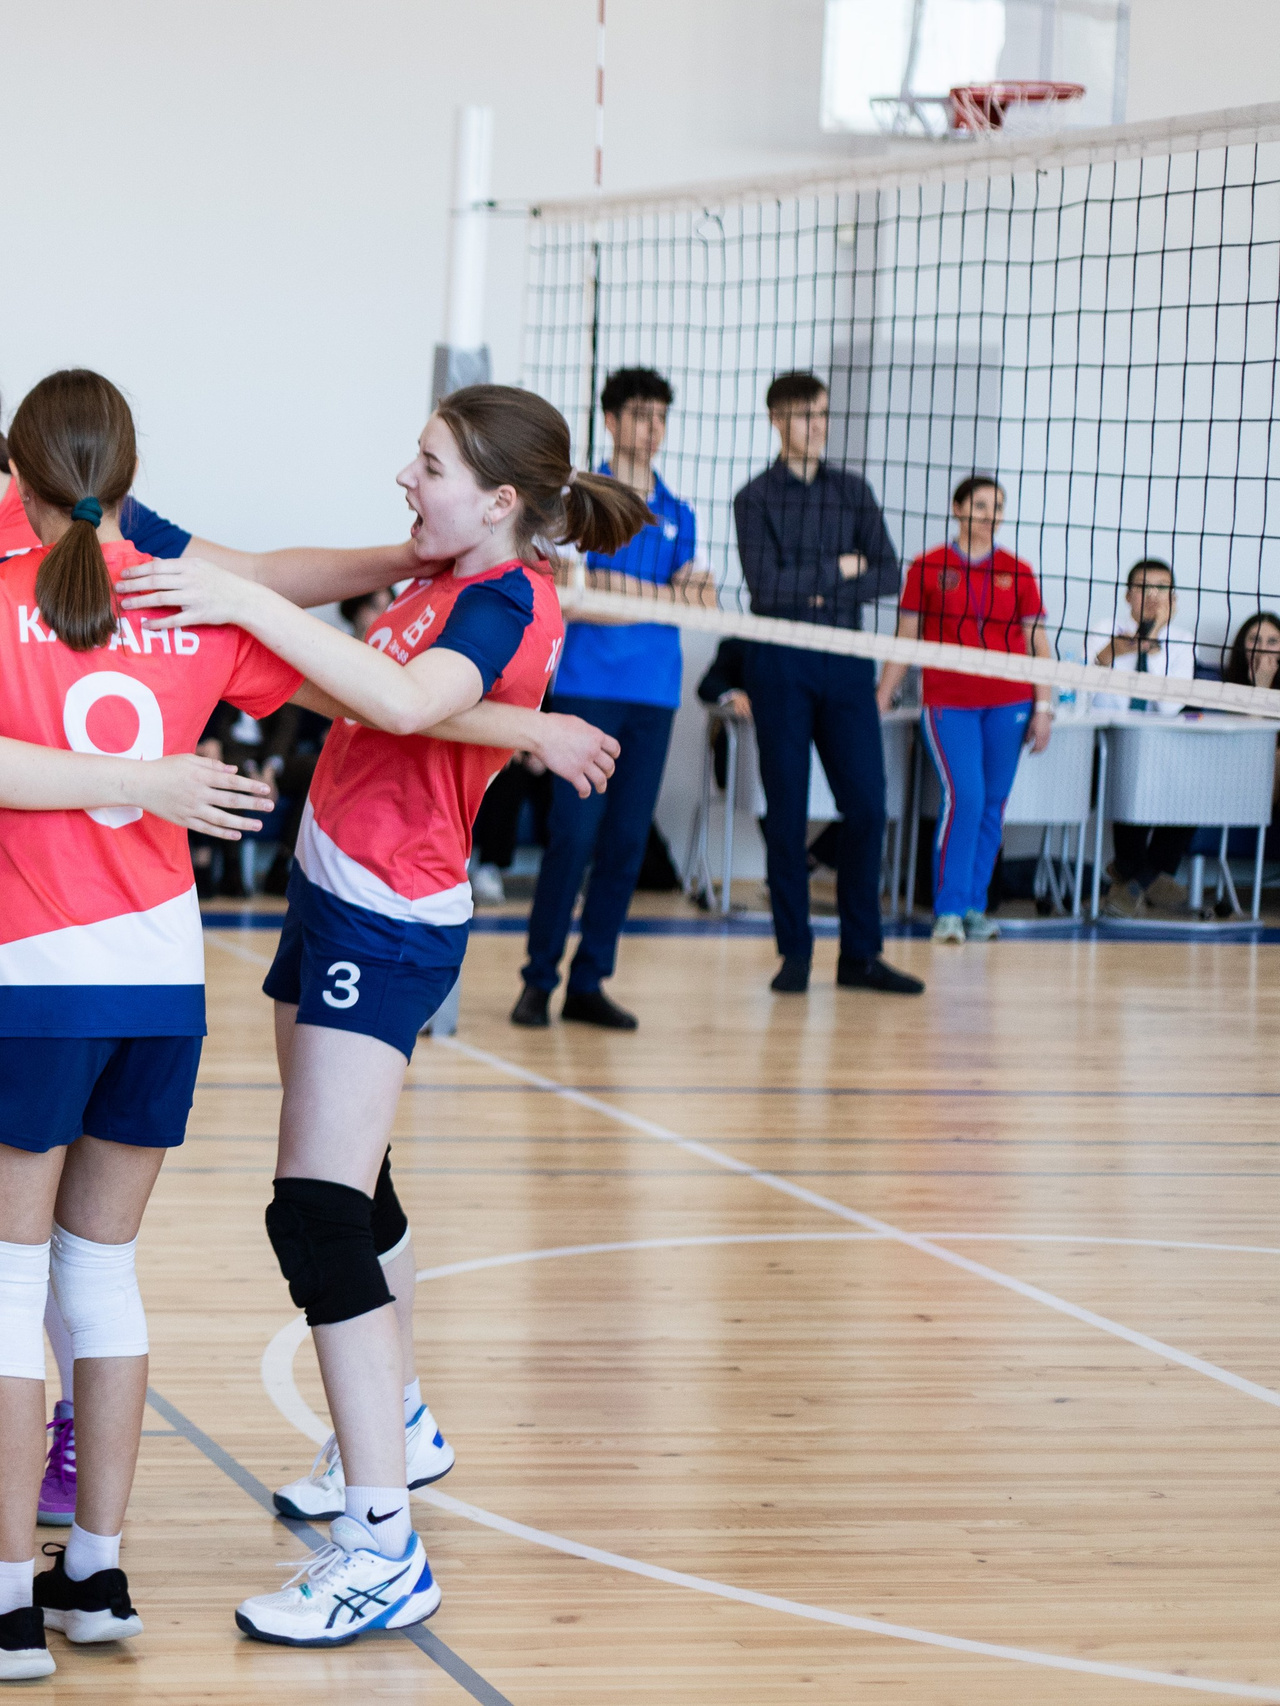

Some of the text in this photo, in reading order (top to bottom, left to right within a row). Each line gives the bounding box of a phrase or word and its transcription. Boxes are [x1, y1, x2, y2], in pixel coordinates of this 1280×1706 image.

[17, 604, 200, 656] КАНЬ
[62, 670, 164, 829] 9
[322, 961, 361, 1009] 3
